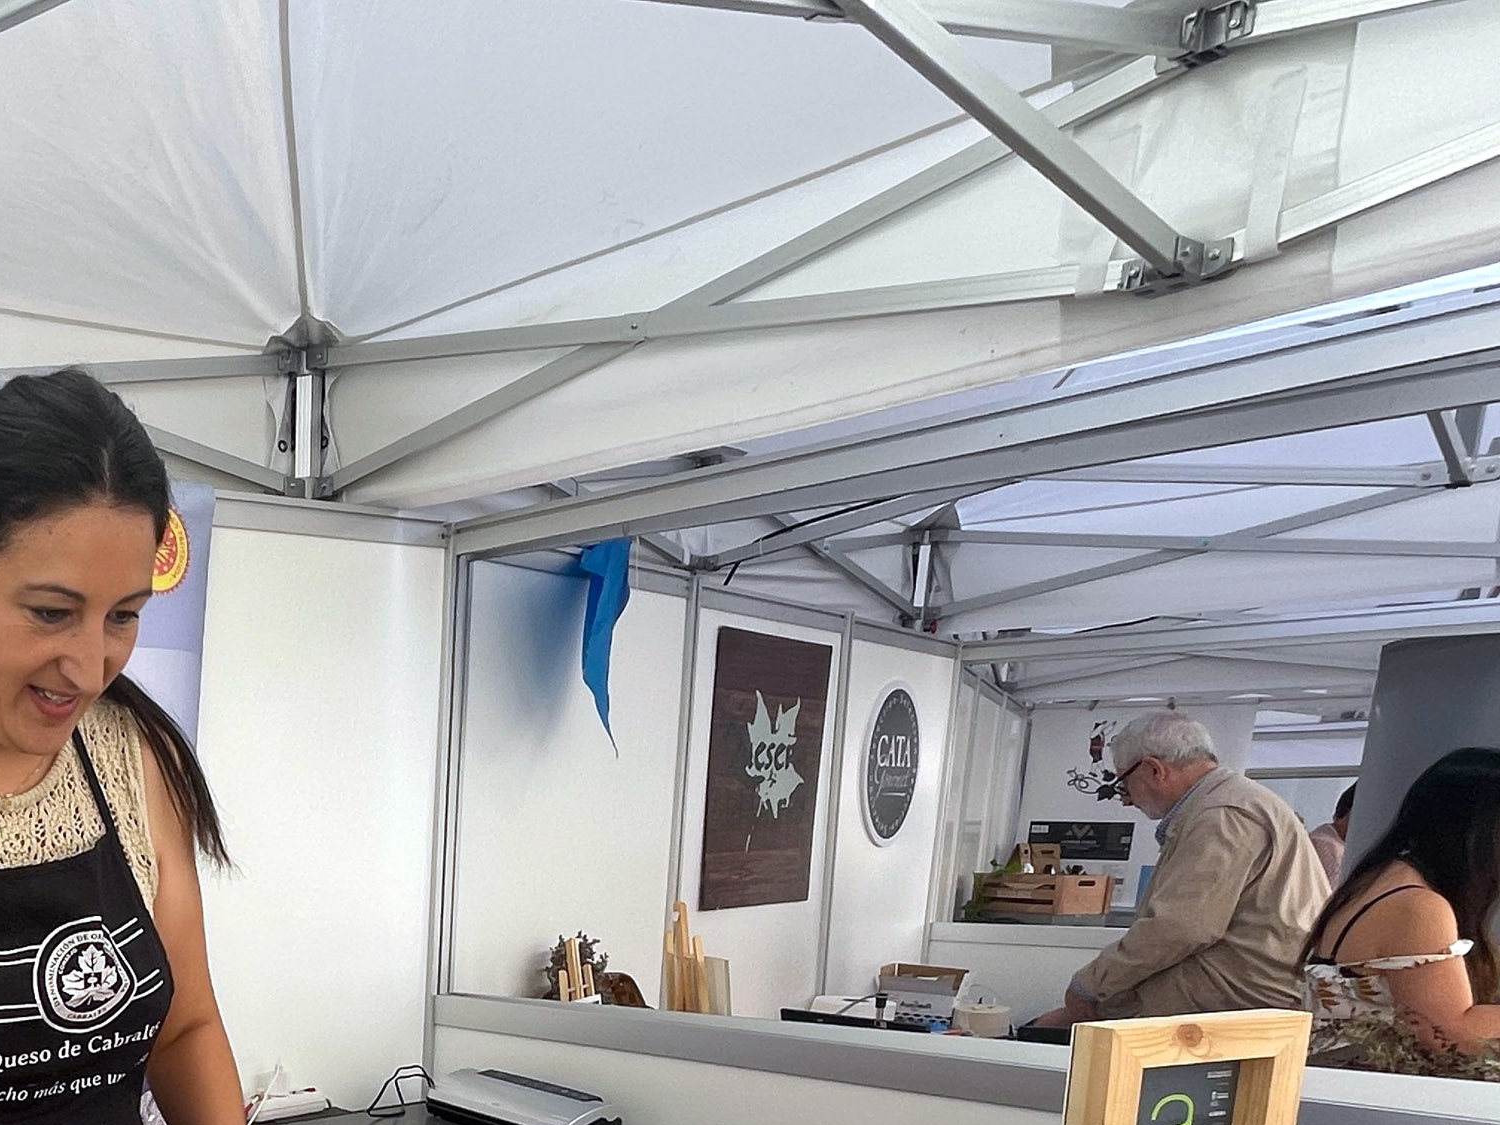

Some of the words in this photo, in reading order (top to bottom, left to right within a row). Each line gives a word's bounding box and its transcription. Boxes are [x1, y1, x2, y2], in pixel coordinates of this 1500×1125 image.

[876, 734, 911, 768] CATA
[57, 1040, 82, 1060] de
[33, 1081, 67, 1099] más
[69, 1073, 103, 1095] que
